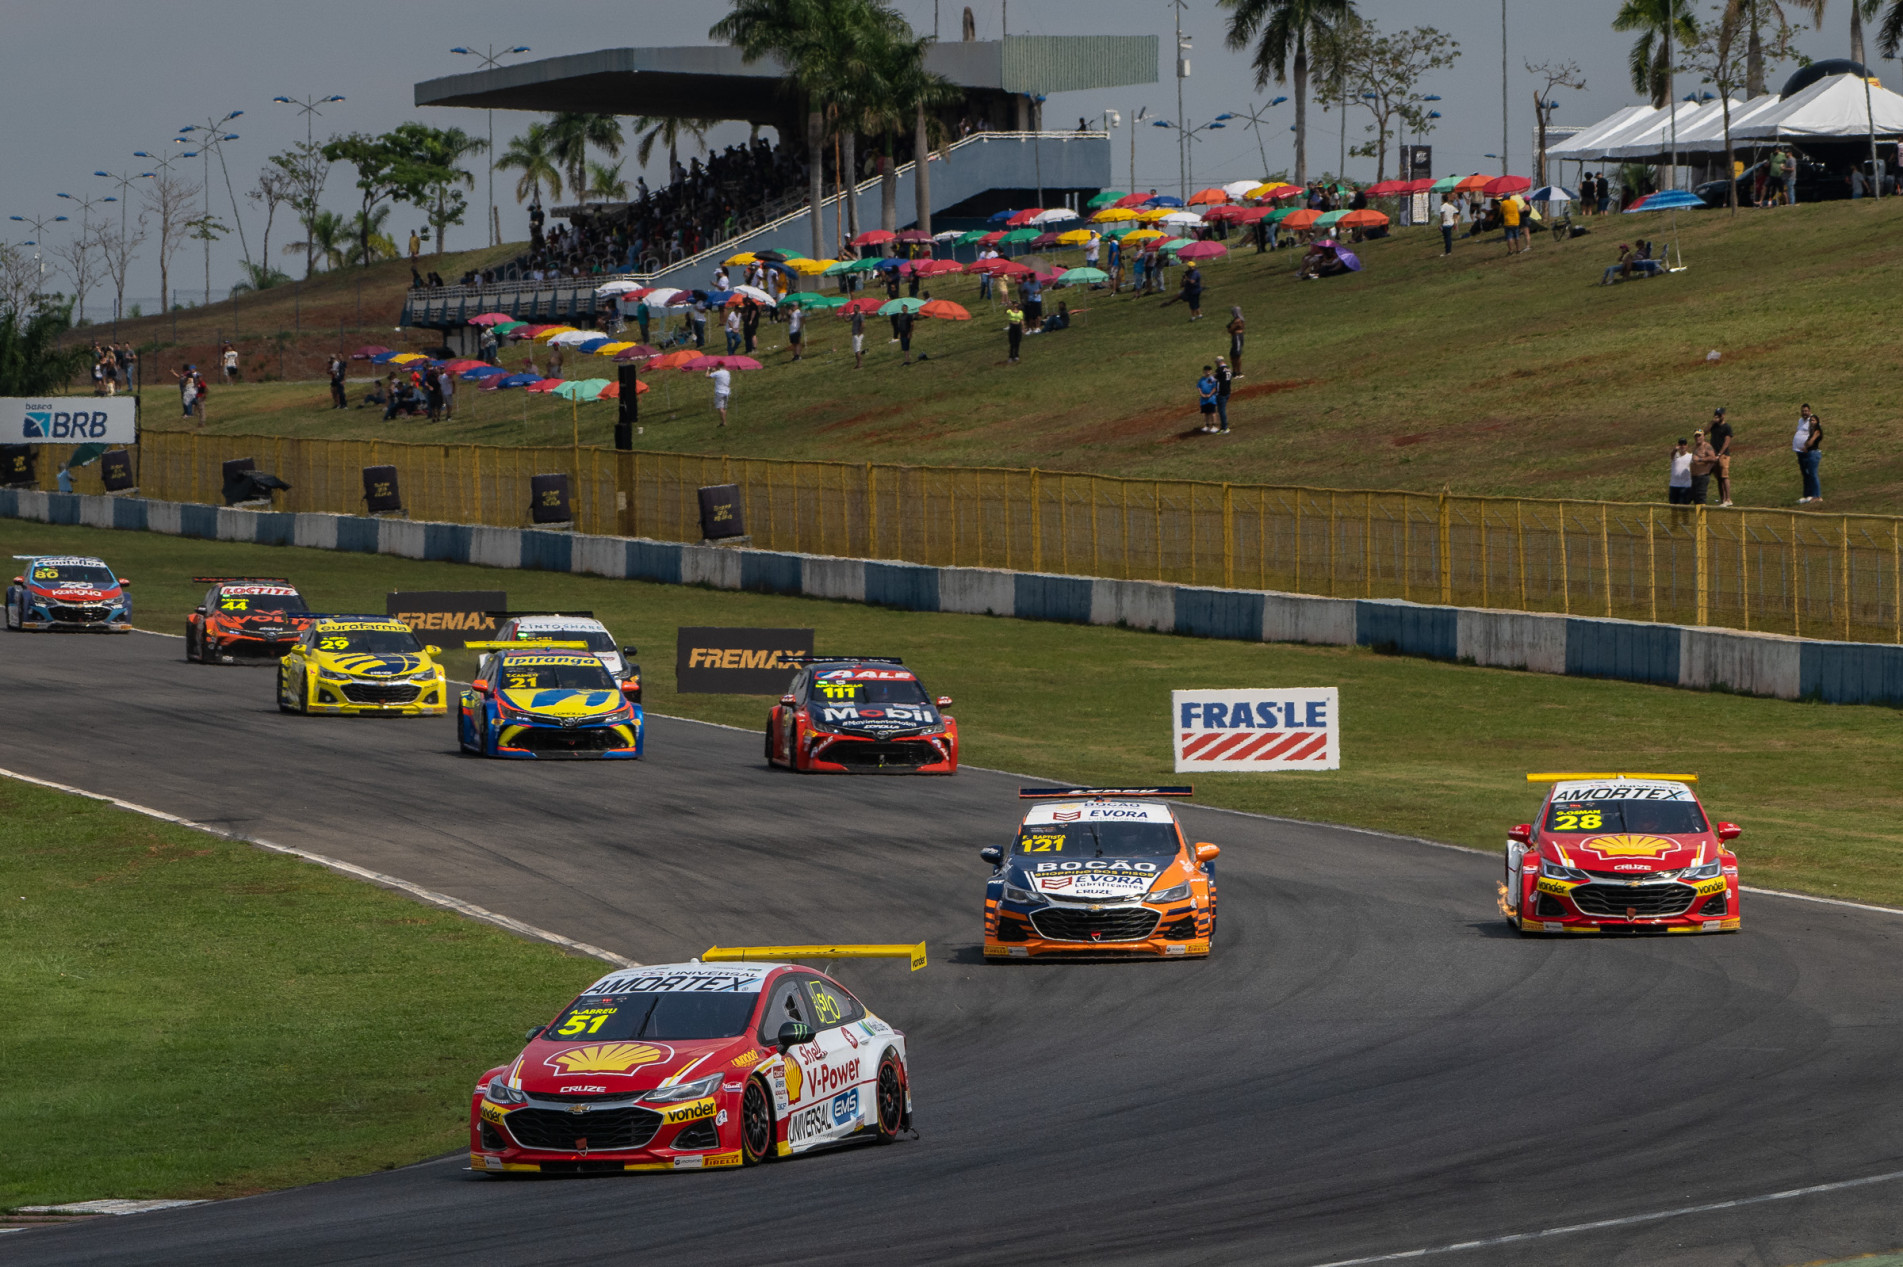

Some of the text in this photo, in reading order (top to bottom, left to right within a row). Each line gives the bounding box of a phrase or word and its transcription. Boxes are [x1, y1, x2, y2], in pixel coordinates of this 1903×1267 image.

[52, 411, 107, 438] BRB
[35, 571, 58, 579] 80
[223, 587, 293, 595] LOCTITE
[221, 602, 247, 610] 44
[398, 612, 496, 630] FREMAX
[321, 622, 407, 632] eurofarma
[320, 640, 349, 649] 29
[508, 656, 596, 665] ipiranga
[689, 648, 806, 669] FREMAX
[509, 677, 537, 688] 21
[823, 687, 855, 698] 111
[823, 707, 933, 722] Mobil
[1554, 788, 1685, 801] AMORTEX
[1090, 809, 1148, 818] EVORA
[1553, 814, 1603, 830] 28
[1021, 838, 1064, 852] 121
[1037, 860, 1157, 872] BOCÃO
[1034, 869, 1091, 878] SHOPPING
[1076, 874, 1144, 885] EVORA
[1075, 882, 1144, 890] Lubrificantes
[667, 970, 757, 978] UNIVERSAL
[584, 976, 758, 995] AMORTEX
[557, 1014, 609, 1036] 51
[806, 1056, 860, 1098] V-Power
[560, 1085, 607, 1093] CRUZE
[834, 1093, 857, 1118] EMS
[789, 1103, 832, 1144] UNIVERSAL
[704, 1154, 739, 1167] PIRELLI
